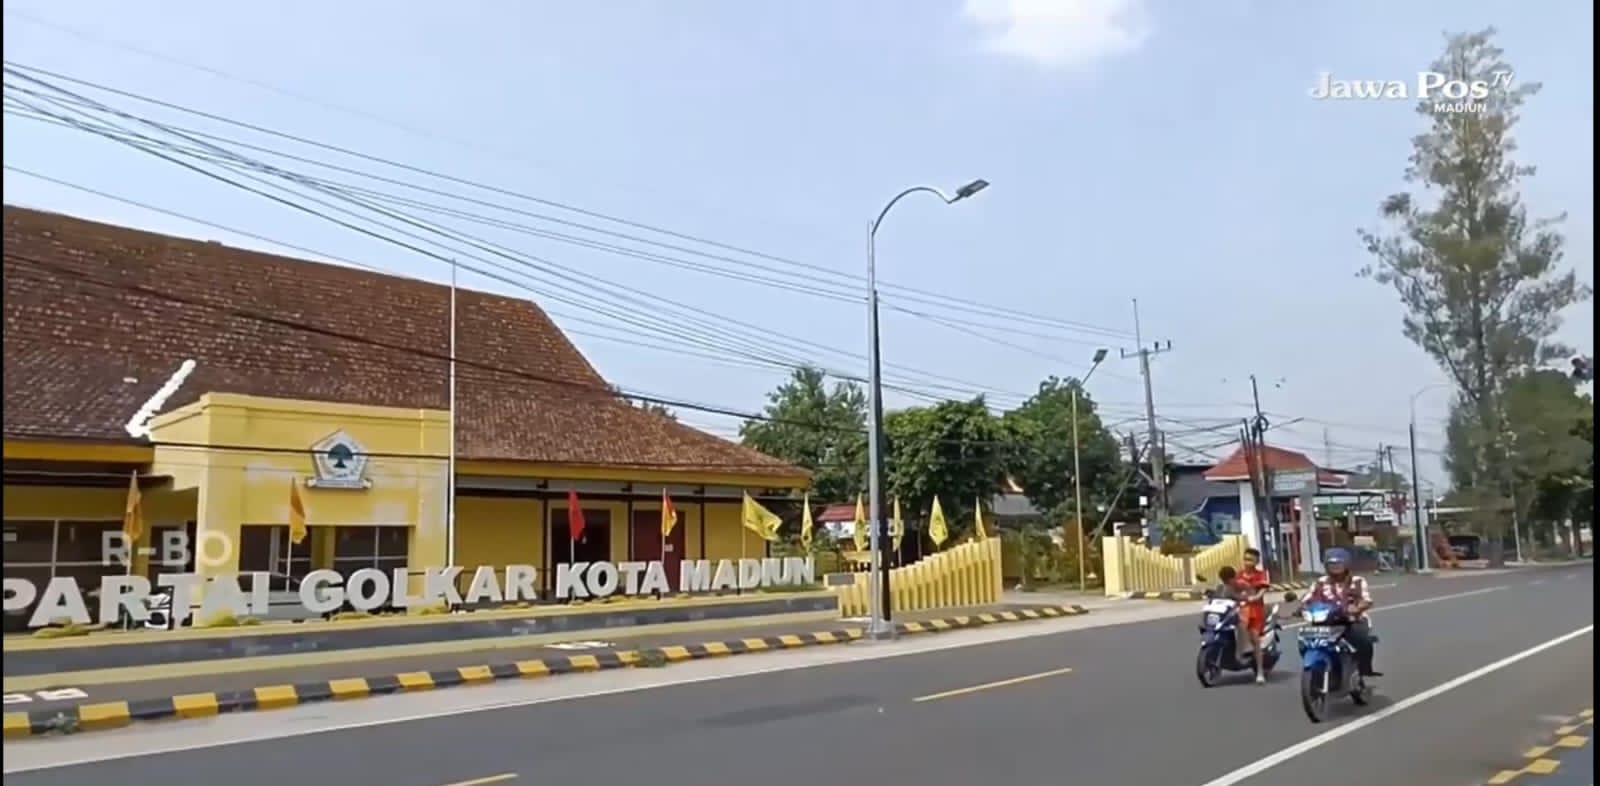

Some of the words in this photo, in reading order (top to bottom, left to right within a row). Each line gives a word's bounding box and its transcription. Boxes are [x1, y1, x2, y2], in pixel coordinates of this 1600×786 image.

[4, 571, 270, 630] PARTAI
[299, 564, 537, 613] GOLKAR
[556, 560, 670, 599] KOTA
[679, 556, 815, 592] MADIUN
